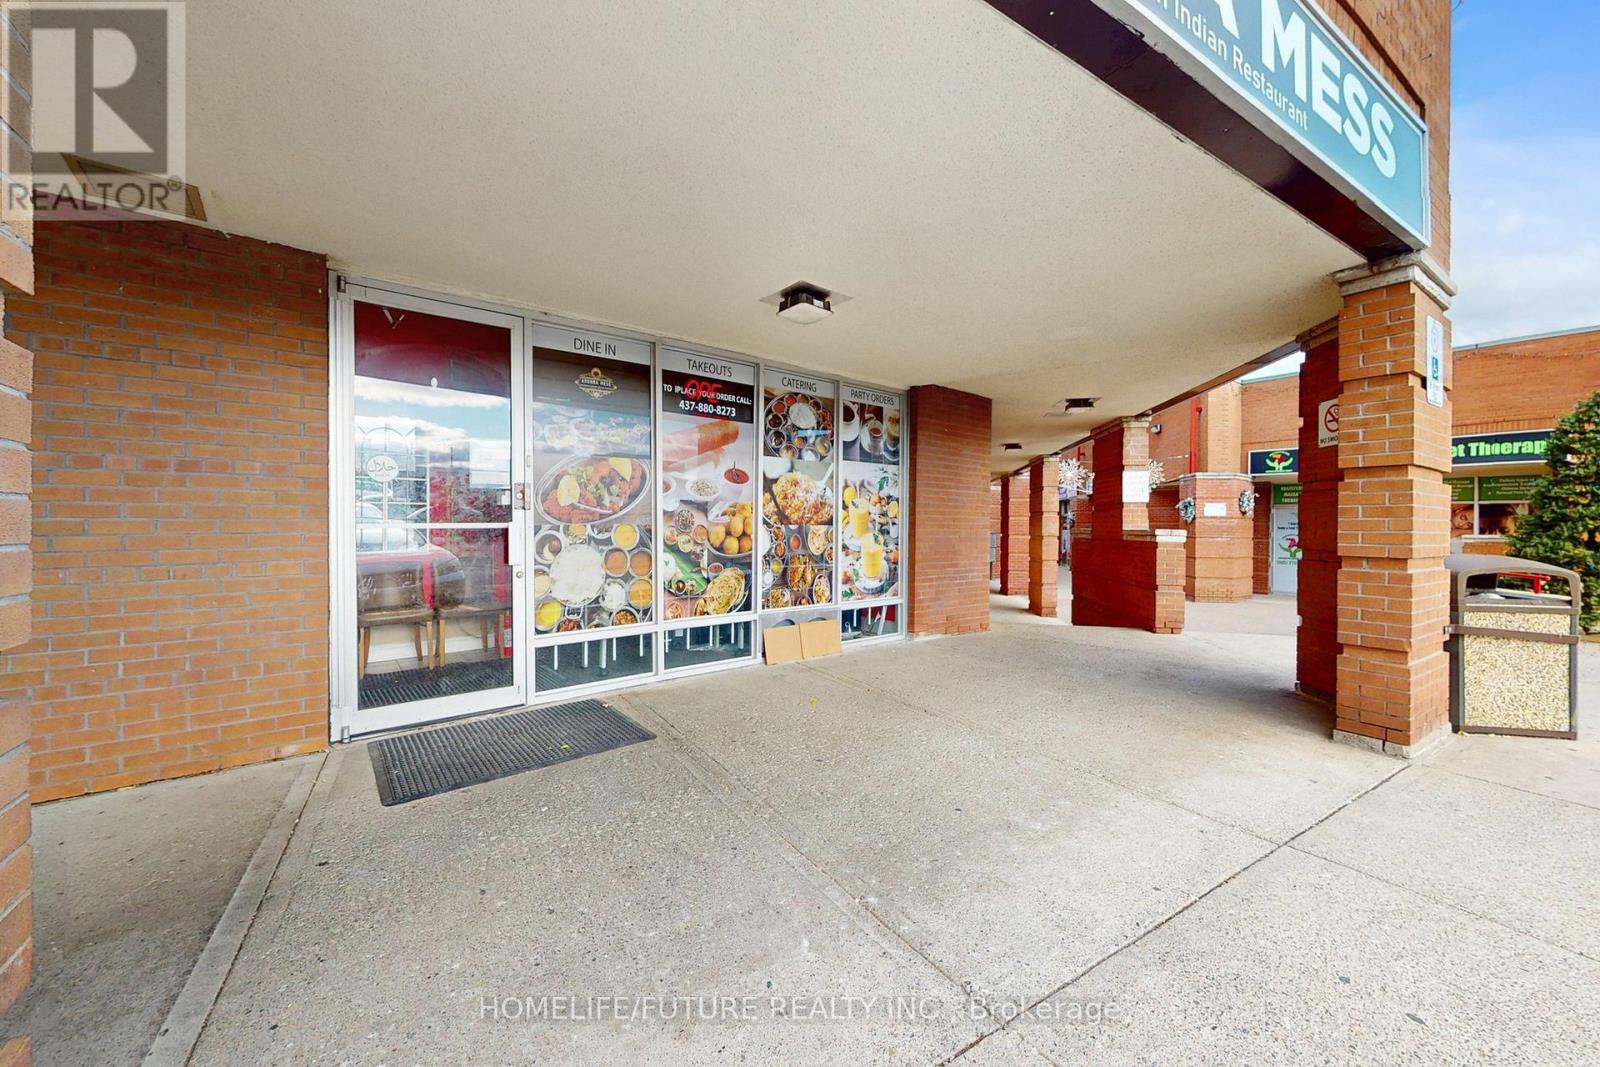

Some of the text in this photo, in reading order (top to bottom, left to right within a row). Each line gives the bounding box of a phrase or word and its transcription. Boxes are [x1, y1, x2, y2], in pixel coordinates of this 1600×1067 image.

[1174, 0, 1228, 63] Indian
[1232, 45, 1309, 131] Restaurant
[1260, 0, 1397, 178] MESS
[573, 337, 617, 356] DINE IN
[686, 358, 733, 378] TAKEOUTS
[781, 376, 817, 393] CATERING
[663, 384, 673, 393] TO
[716, 393, 736, 403] ORDER
[736, 396, 753, 405] CALL:
[850, 389, 895, 406] PARTY ORDERS
[679, 399, 737, 417] 437-880-8273
